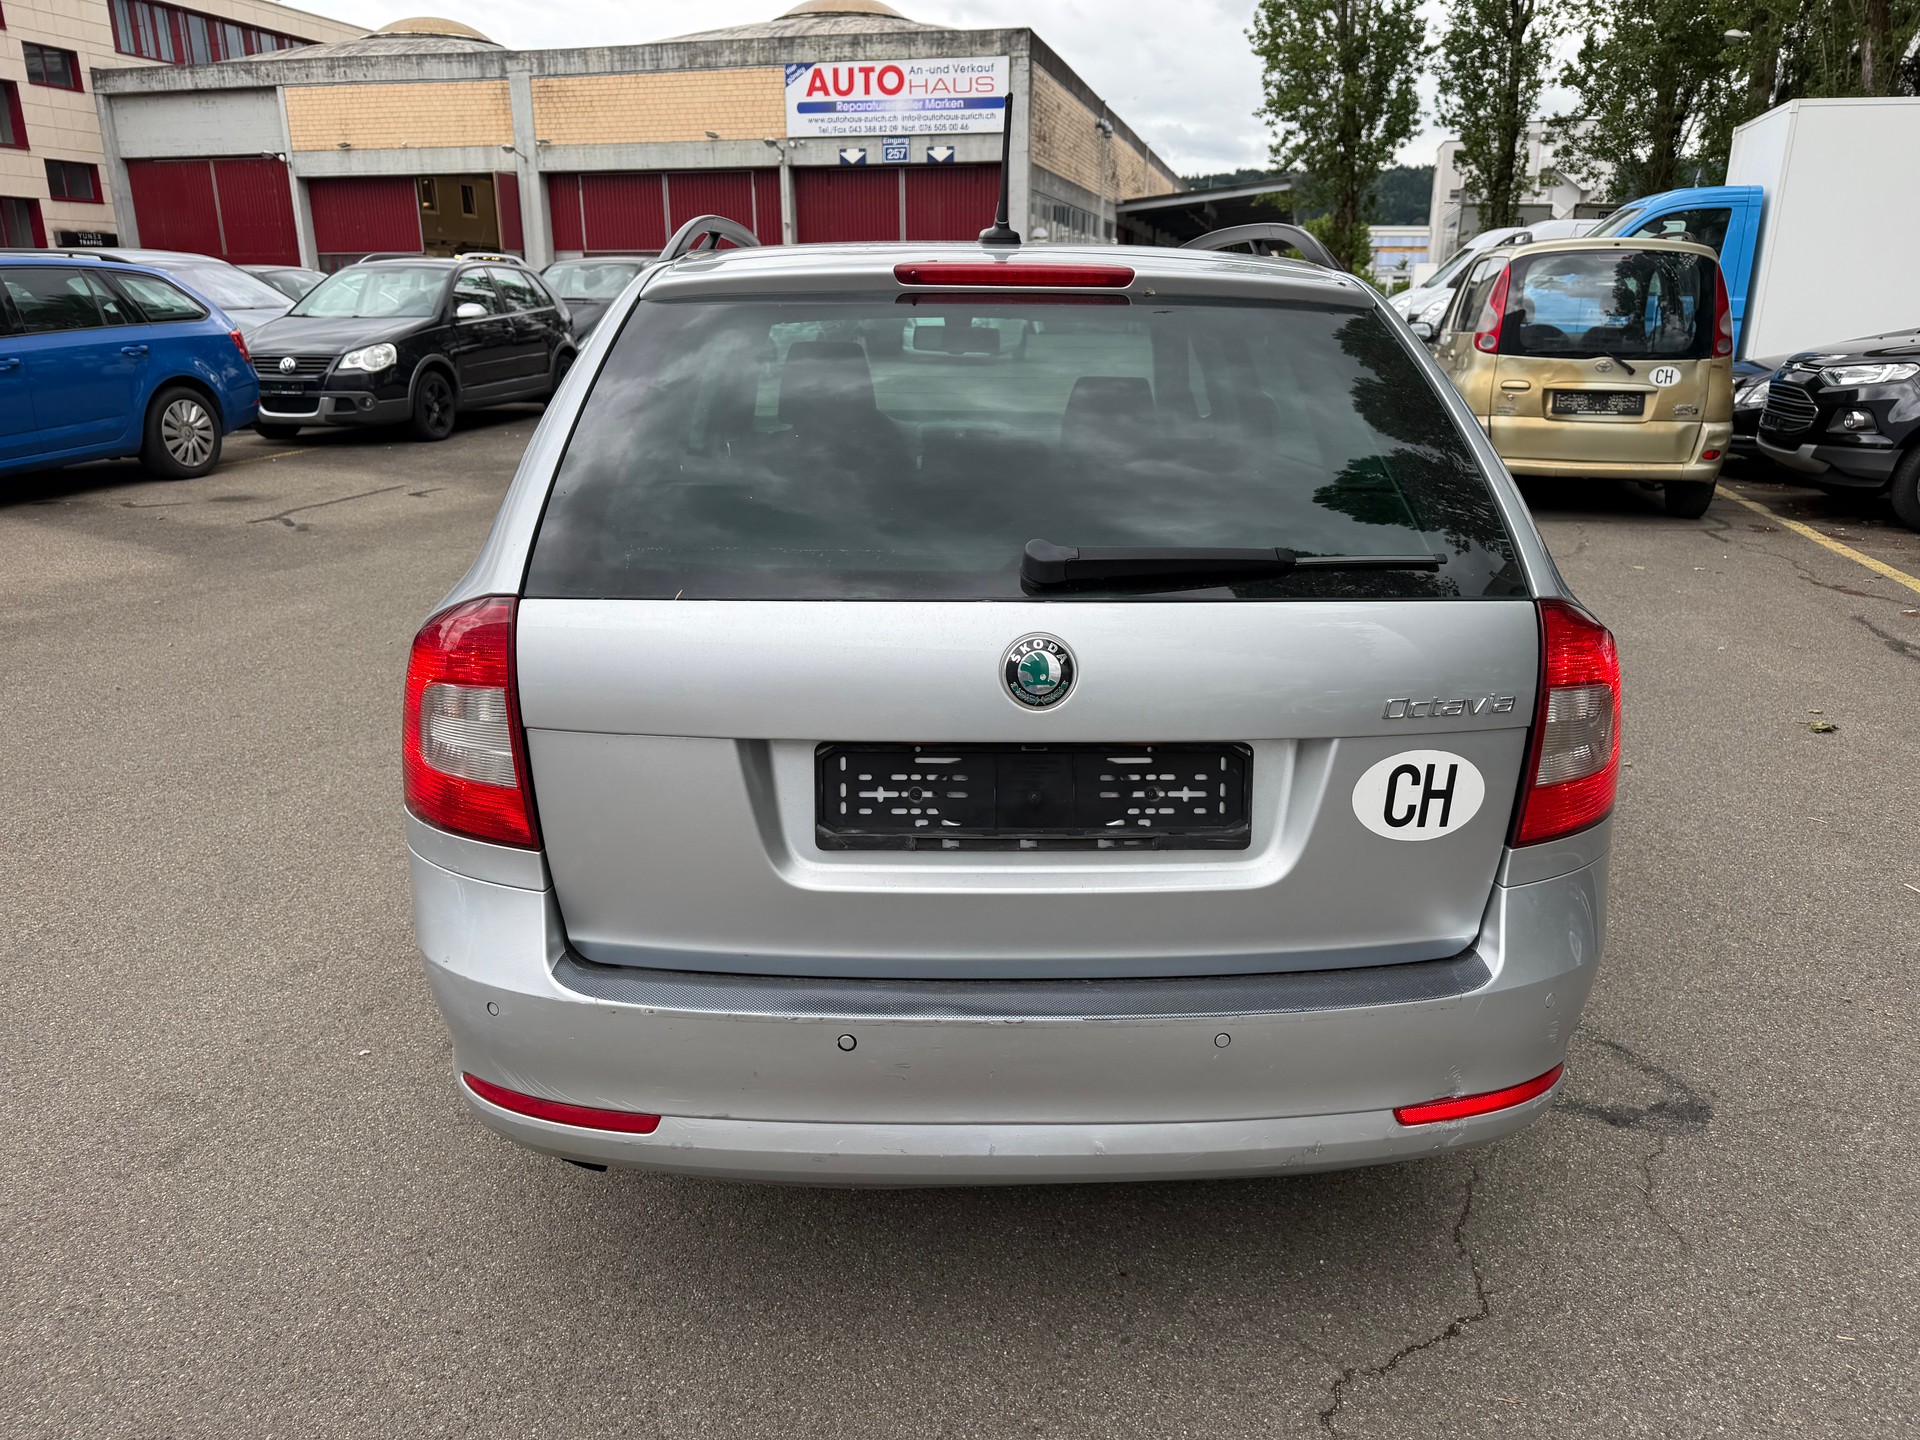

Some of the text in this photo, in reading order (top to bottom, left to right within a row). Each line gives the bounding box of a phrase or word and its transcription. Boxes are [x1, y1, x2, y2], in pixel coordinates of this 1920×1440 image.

[909, 66, 924, 76] An
[952, 62, 996, 74] Verkauf
[805, 64, 996, 97] AUTO HAUS
[925, 98, 965, 110] Marken
[883, 137, 910, 145] Eingang
[886, 148, 906, 160] 257
[1654, 368, 1675, 385] CH
[1381, 691, 1517, 720] Octavia
[1382, 763, 1459, 829] CH
